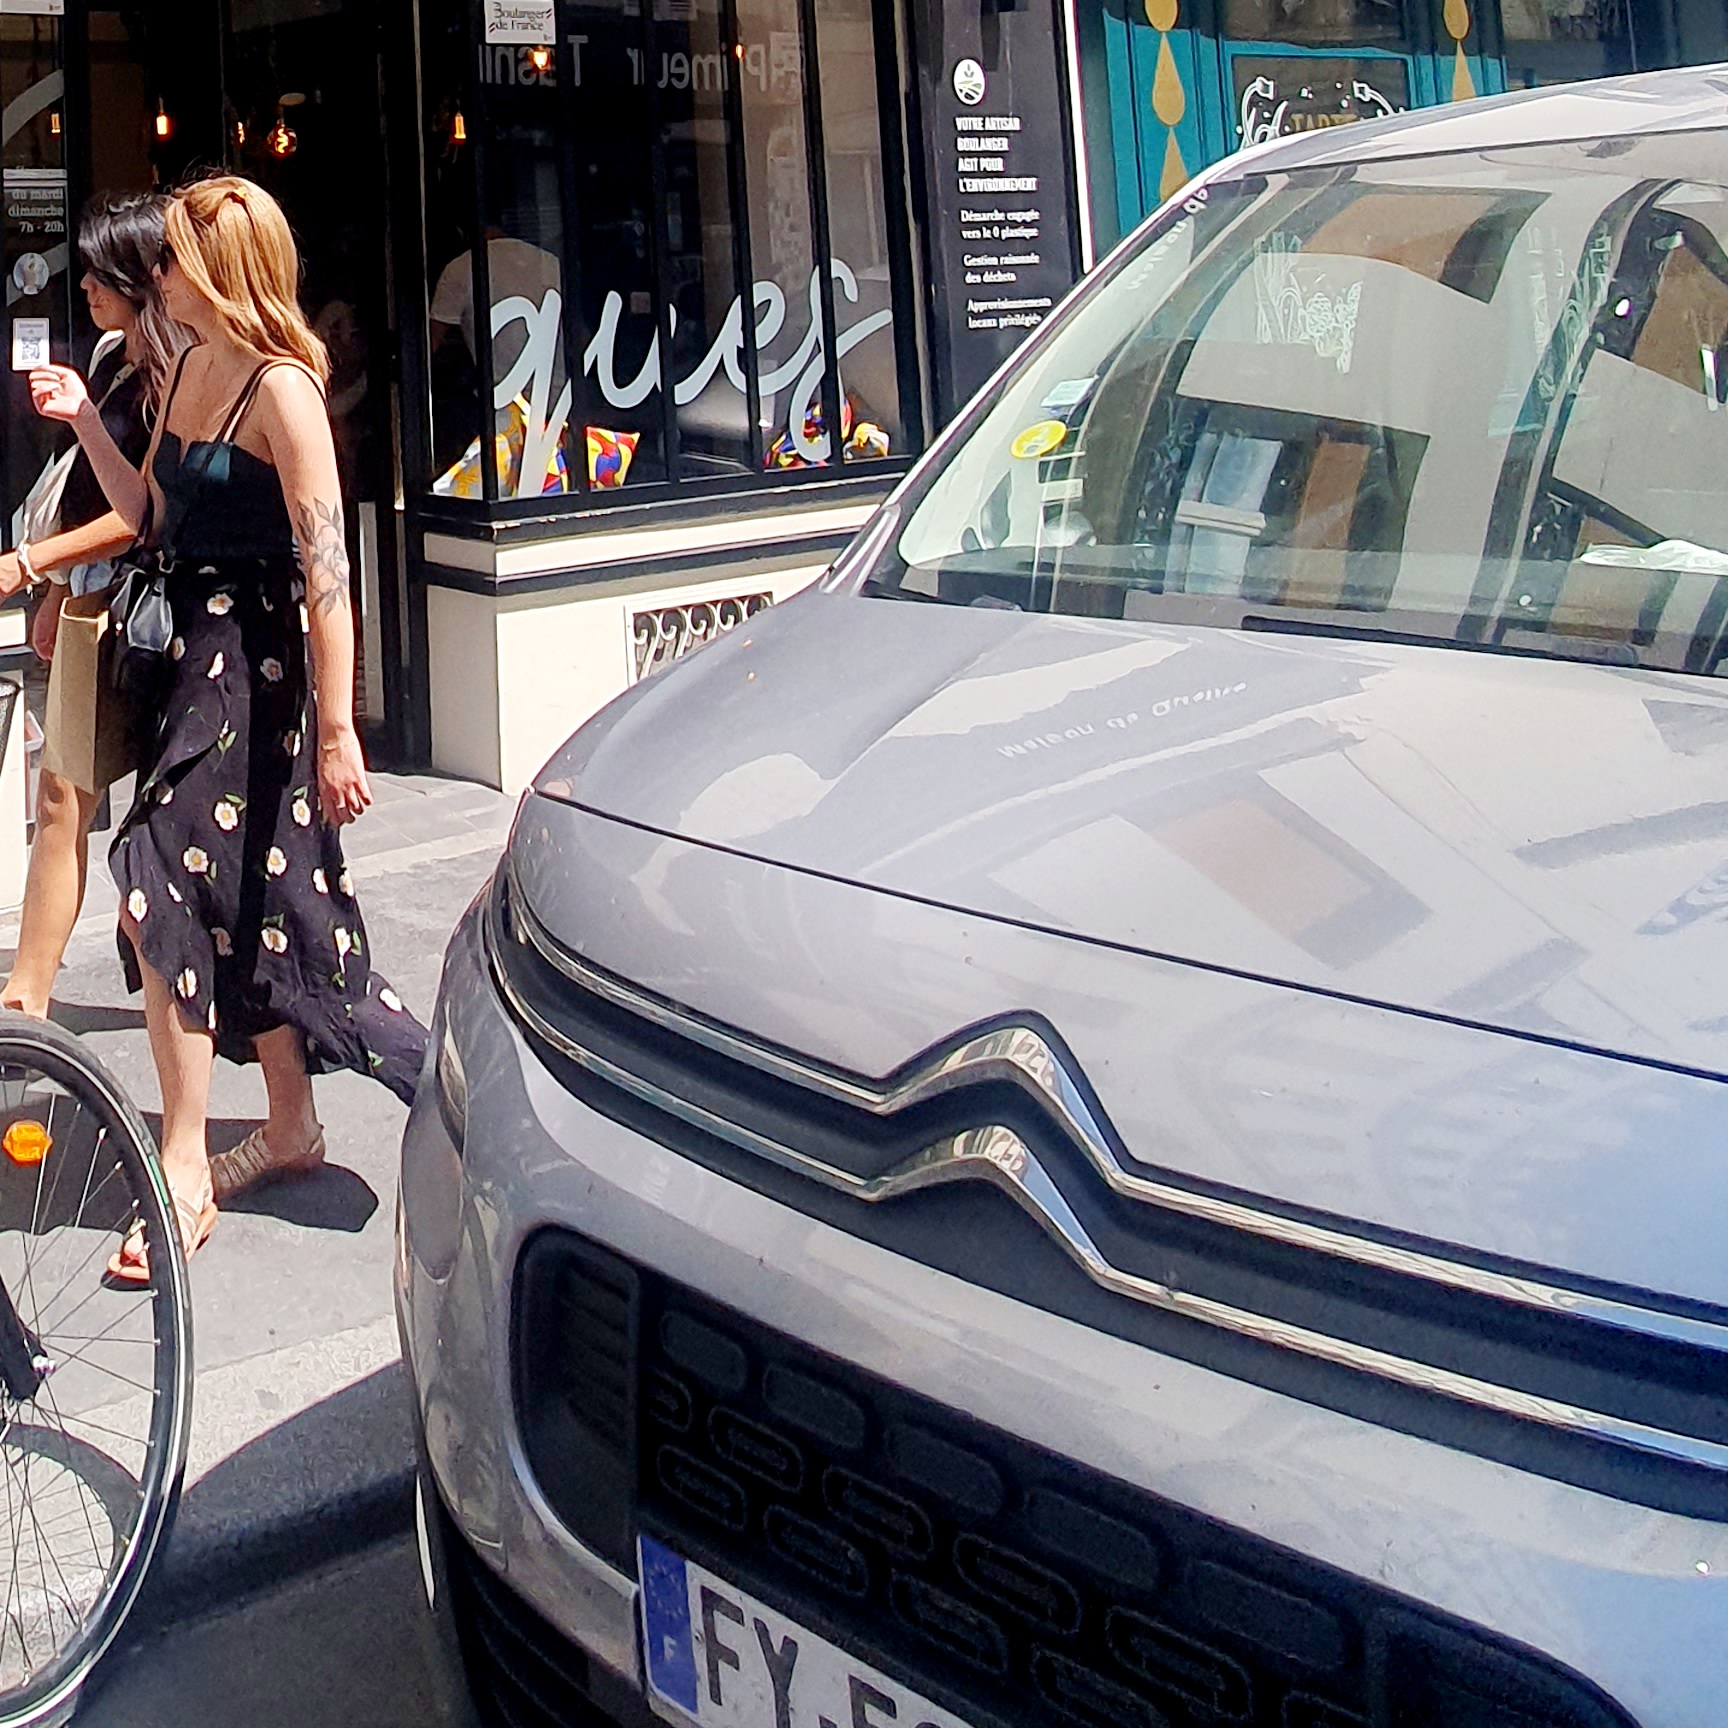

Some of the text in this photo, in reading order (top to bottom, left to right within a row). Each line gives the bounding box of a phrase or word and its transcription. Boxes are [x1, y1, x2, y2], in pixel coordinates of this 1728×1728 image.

[955, 117, 1021, 131] VOTRE ARTISAN
[956, 137, 1010, 152] BOULANGER
[957, 157, 1004, 172] AGIT POUR
[8, 203, 64, 217] dimanche
[960, 209, 1005, 222] Démarche
[19, 220, 34, 233] 7h
[44, 220, 65, 233] 20h
[961, 229, 981, 240] vers
[982, 225, 992, 239] le
[1000, 225, 1040, 240] plastique
[963, 254, 999, 267] Gestion
[964, 269, 1017, 284] des déchets
[968, 315, 998, 329] locaux
